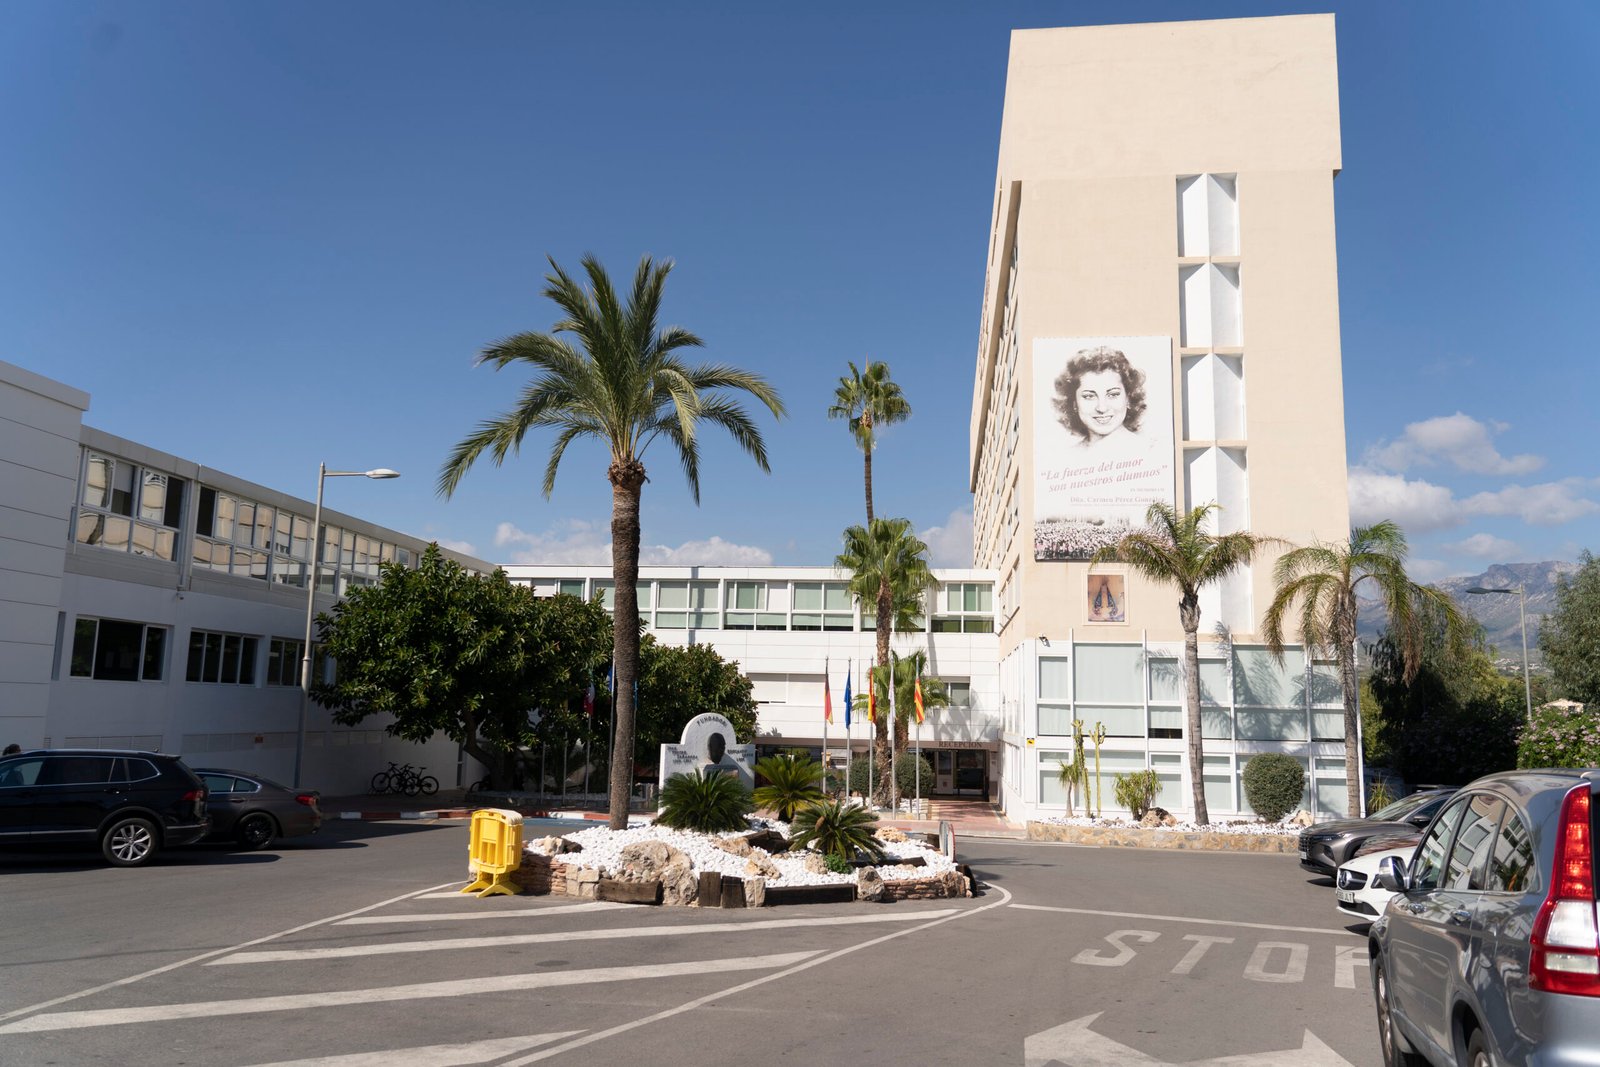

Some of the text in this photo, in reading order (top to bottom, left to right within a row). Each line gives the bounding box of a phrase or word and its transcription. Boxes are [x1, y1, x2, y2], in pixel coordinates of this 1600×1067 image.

[1061, 465, 1095, 481] fuerza
[1098, 461, 1113, 473] del
[1116, 458, 1144, 470] amor
[1049, 483, 1067, 493] son
[1070, 475, 1114, 490] nuestros
[1070, 929, 1370, 989] STOP
